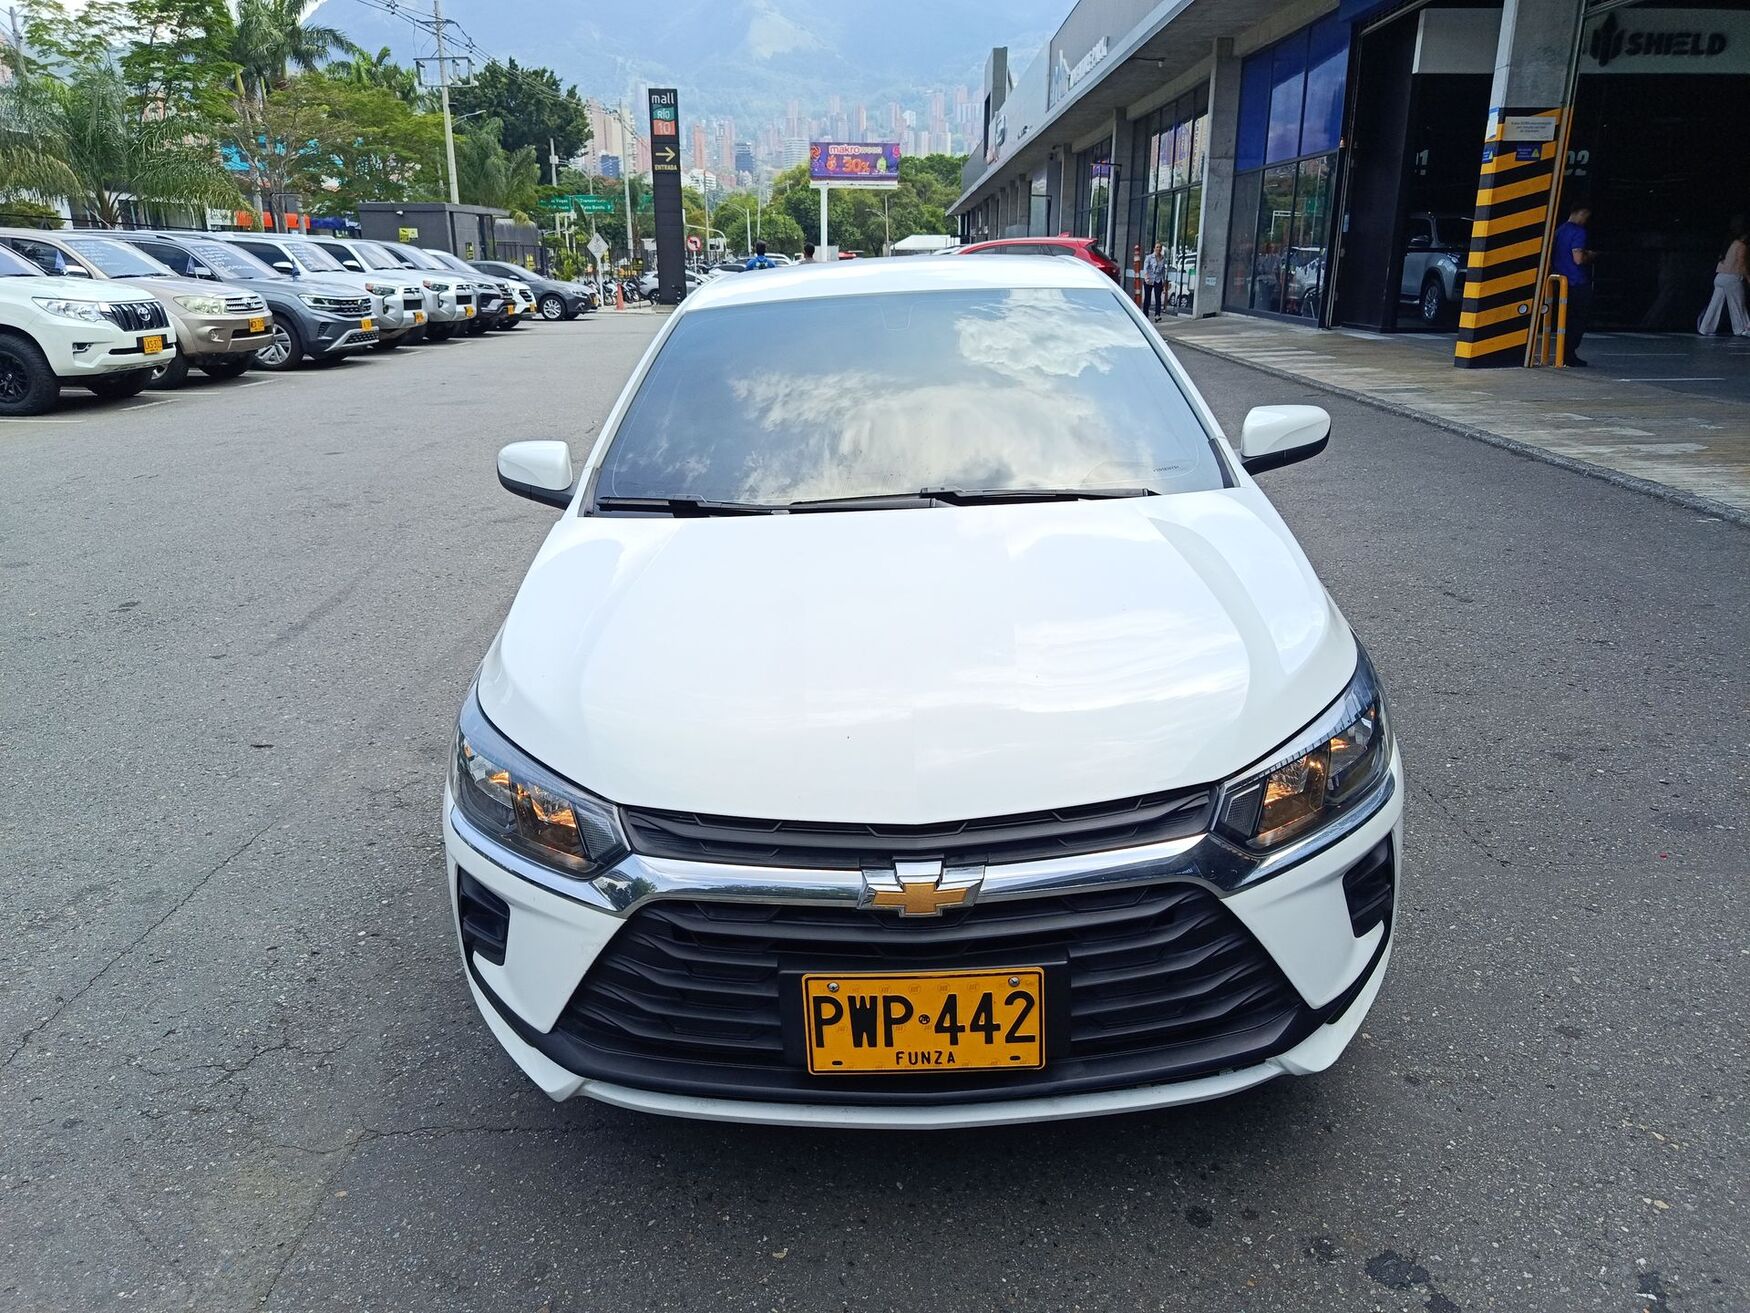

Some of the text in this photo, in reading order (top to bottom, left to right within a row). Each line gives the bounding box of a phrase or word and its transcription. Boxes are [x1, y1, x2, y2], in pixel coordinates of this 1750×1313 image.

[1624, 31, 1727, 56] SHIELD
[651, 93, 674, 104] mall
[657, 121, 671, 134] 10
[829, 144, 860, 155] makro
[842, 156, 871, 173] 30%
[895, 1050, 956, 1066] FUNZA
